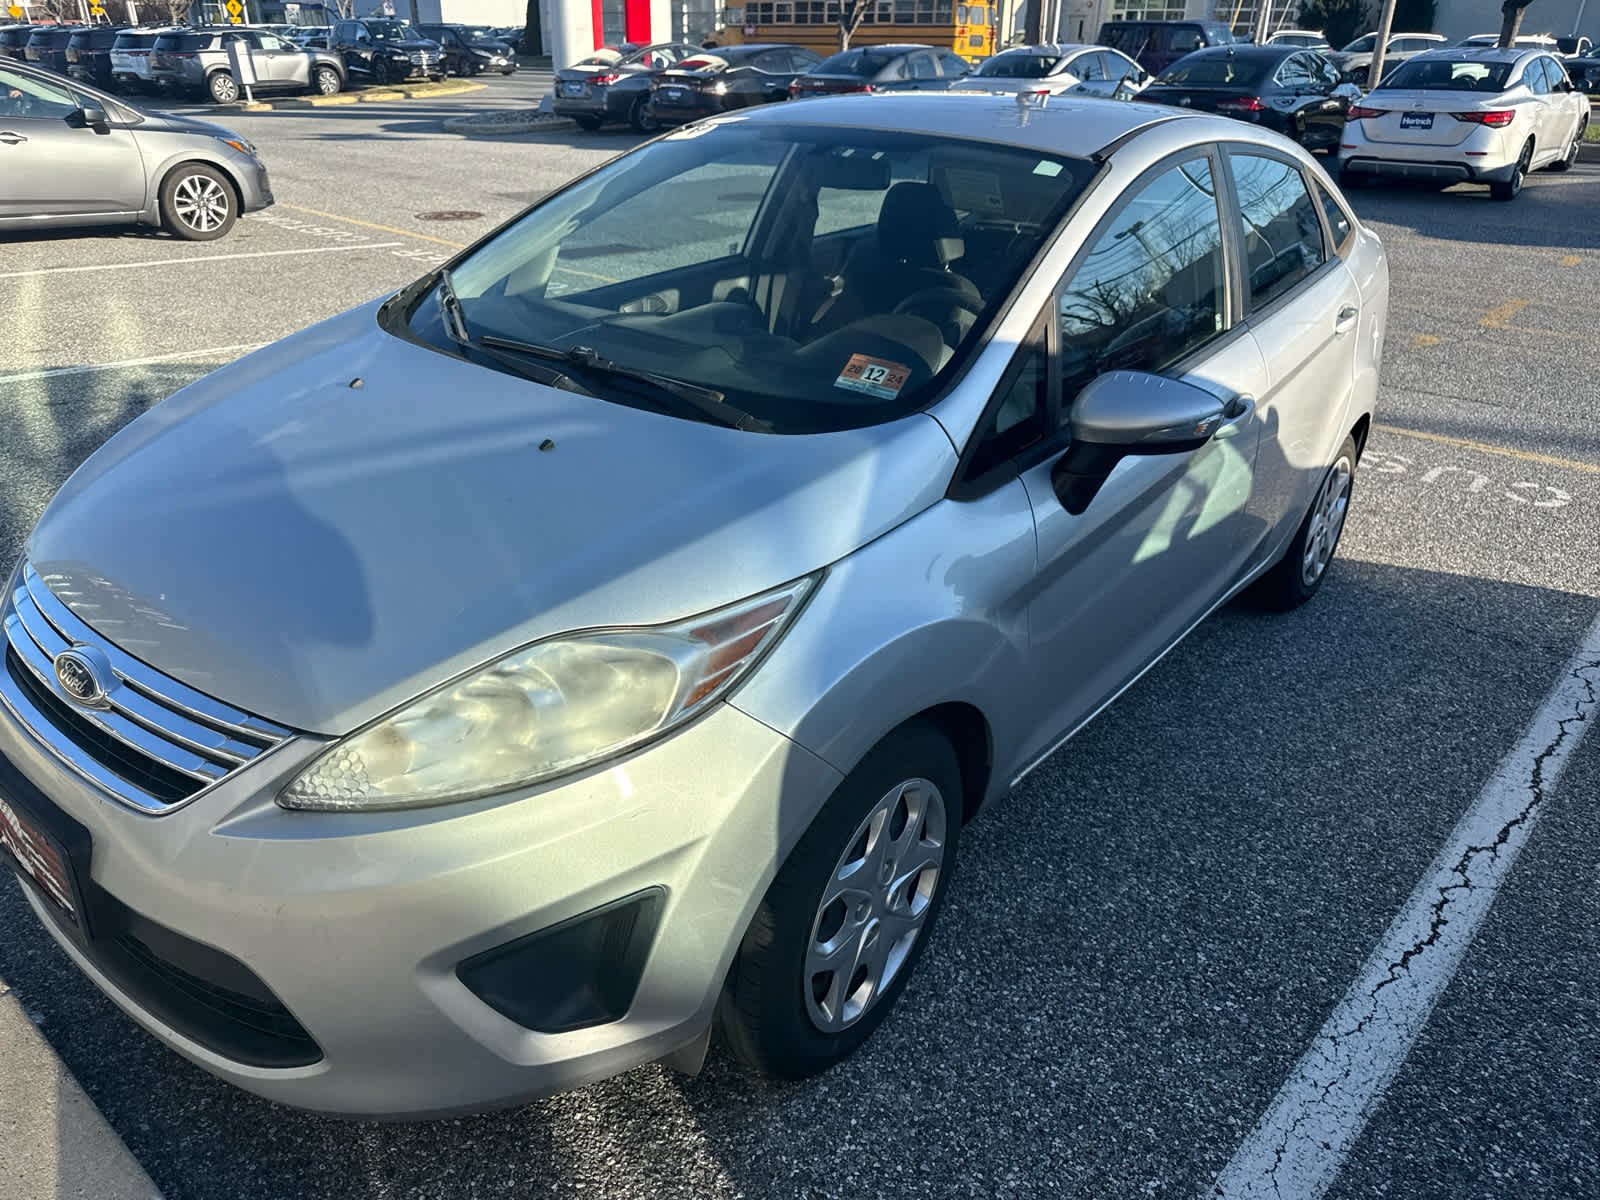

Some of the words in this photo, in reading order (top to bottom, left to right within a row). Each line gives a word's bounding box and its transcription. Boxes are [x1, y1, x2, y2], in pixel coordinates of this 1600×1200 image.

[864, 367, 886, 382] 12
[887, 374, 904, 384] 24
[60, 660, 89, 694] Ford
